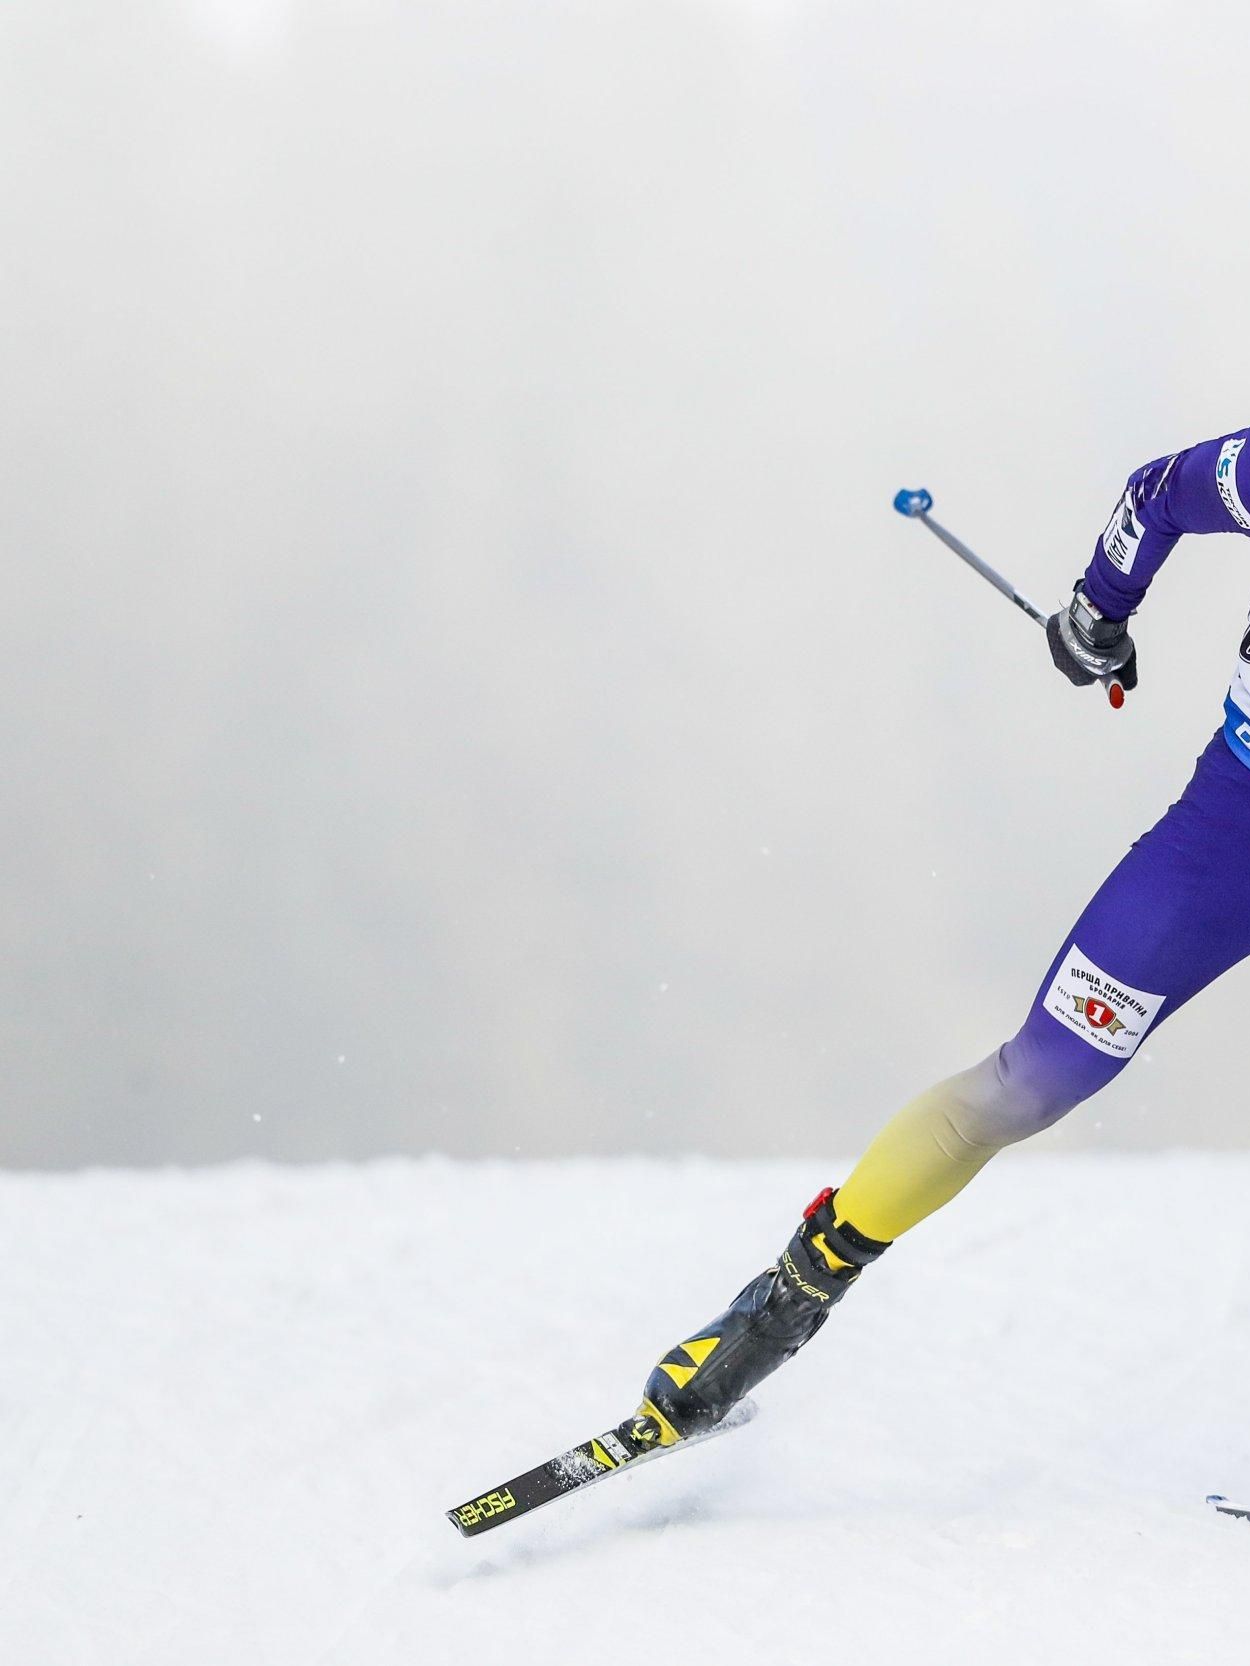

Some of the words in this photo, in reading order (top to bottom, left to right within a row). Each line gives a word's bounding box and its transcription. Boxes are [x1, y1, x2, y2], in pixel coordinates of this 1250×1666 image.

[1071, 967, 1101, 986] ПЕРША
[1104, 982, 1147, 1018] ПРИВАТНА
[1088, 1003, 1106, 1025] 1
[783, 1251, 830, 1302] SCHER
[454, 1488, 516, 1526] FISCHER
